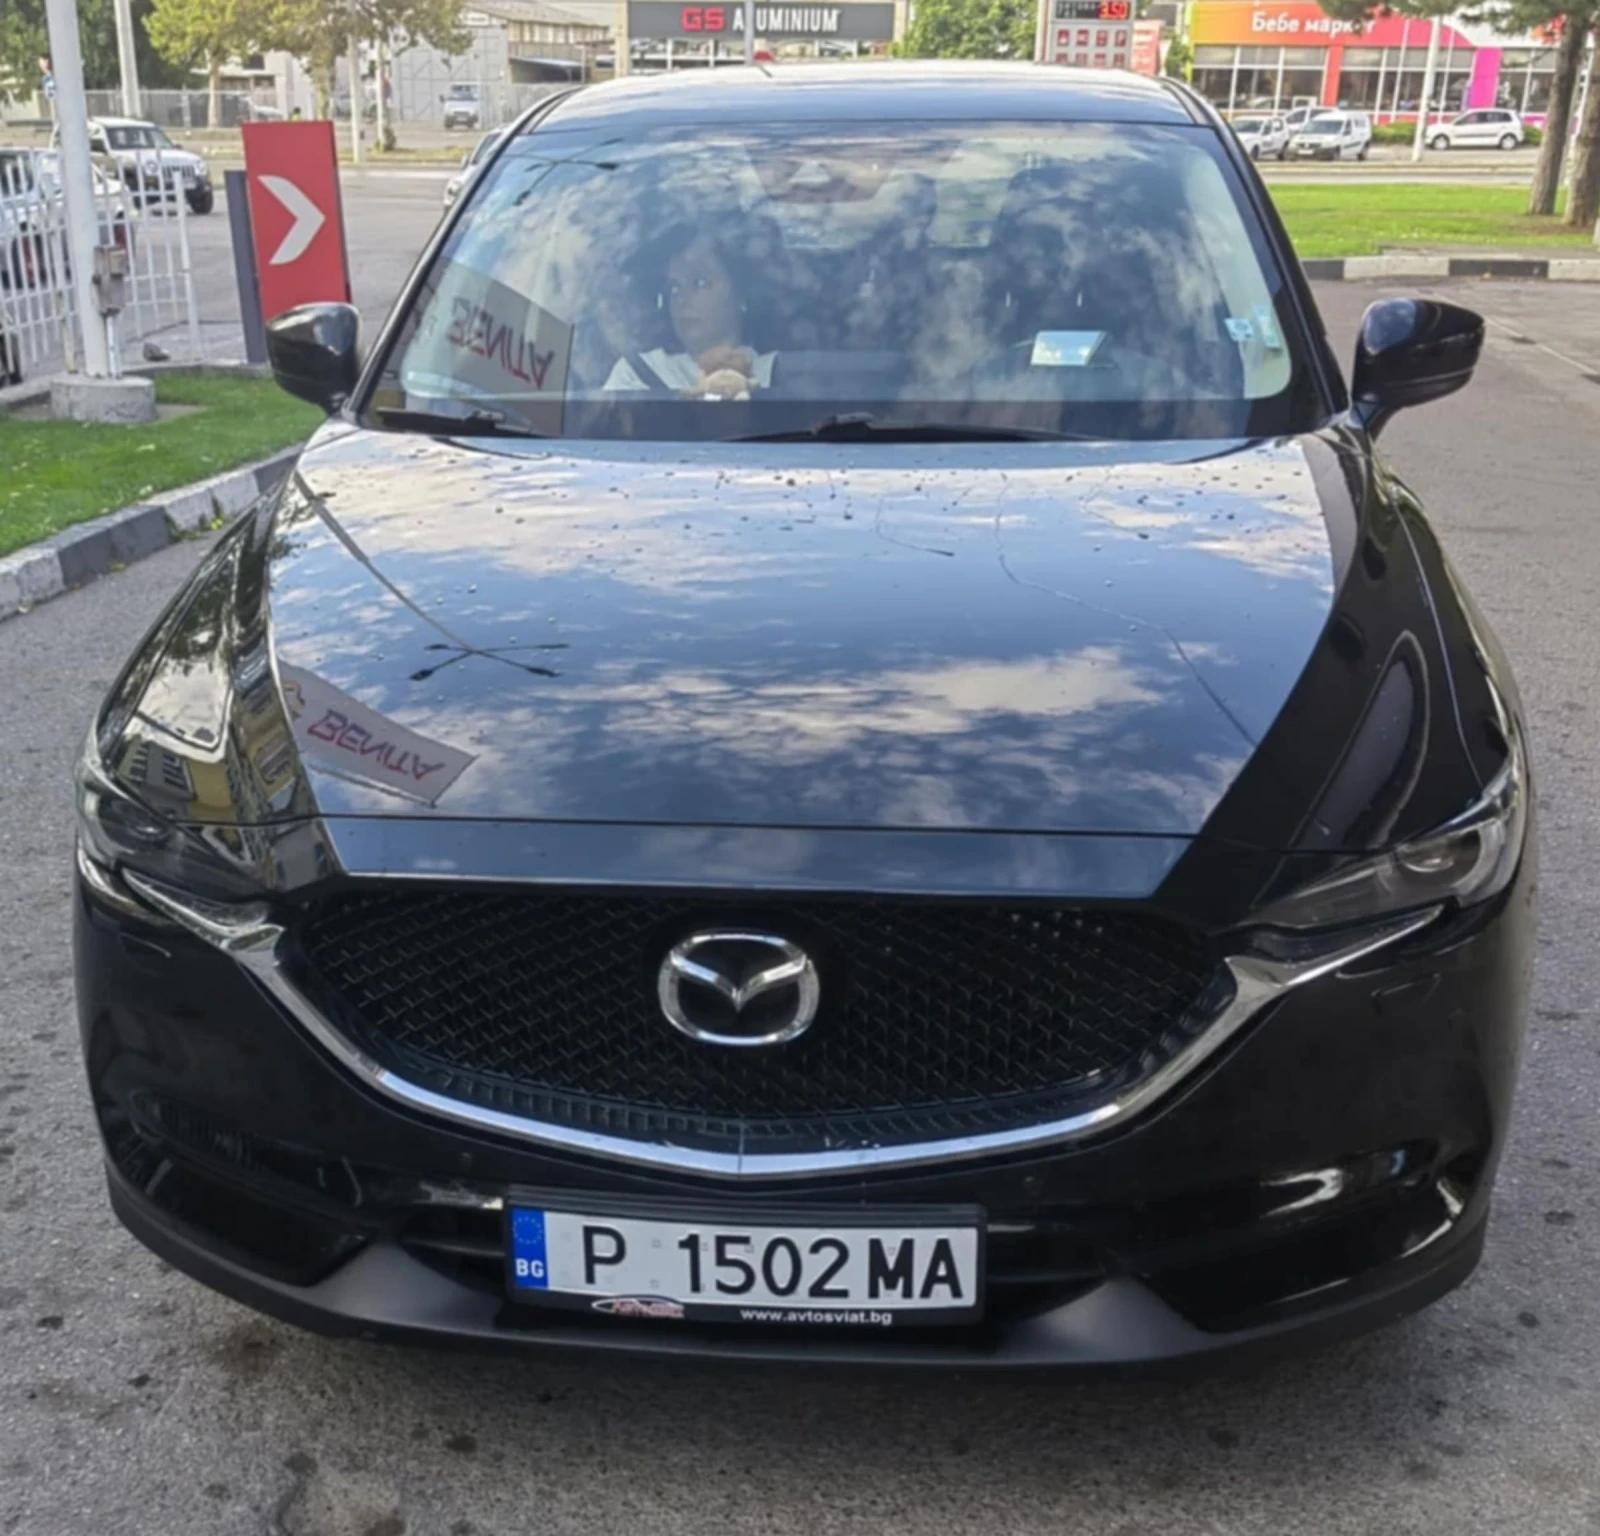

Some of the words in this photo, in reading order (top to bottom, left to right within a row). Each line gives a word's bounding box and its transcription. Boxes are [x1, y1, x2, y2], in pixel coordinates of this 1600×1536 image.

[681, 7, 725, 32] GS
[732, 7, 841, 32] AUMINIUM
[1252, 11, 1299, 32] Бебе
[515, 1259, 544, 1278] BG
[582, 1225, 627, 1285] P
[678, 1233, 850, 1299] 1502
[868, 1238, 964, 1300] MA
[739, 1308, 893, 1326] www.avtosviat.bg
